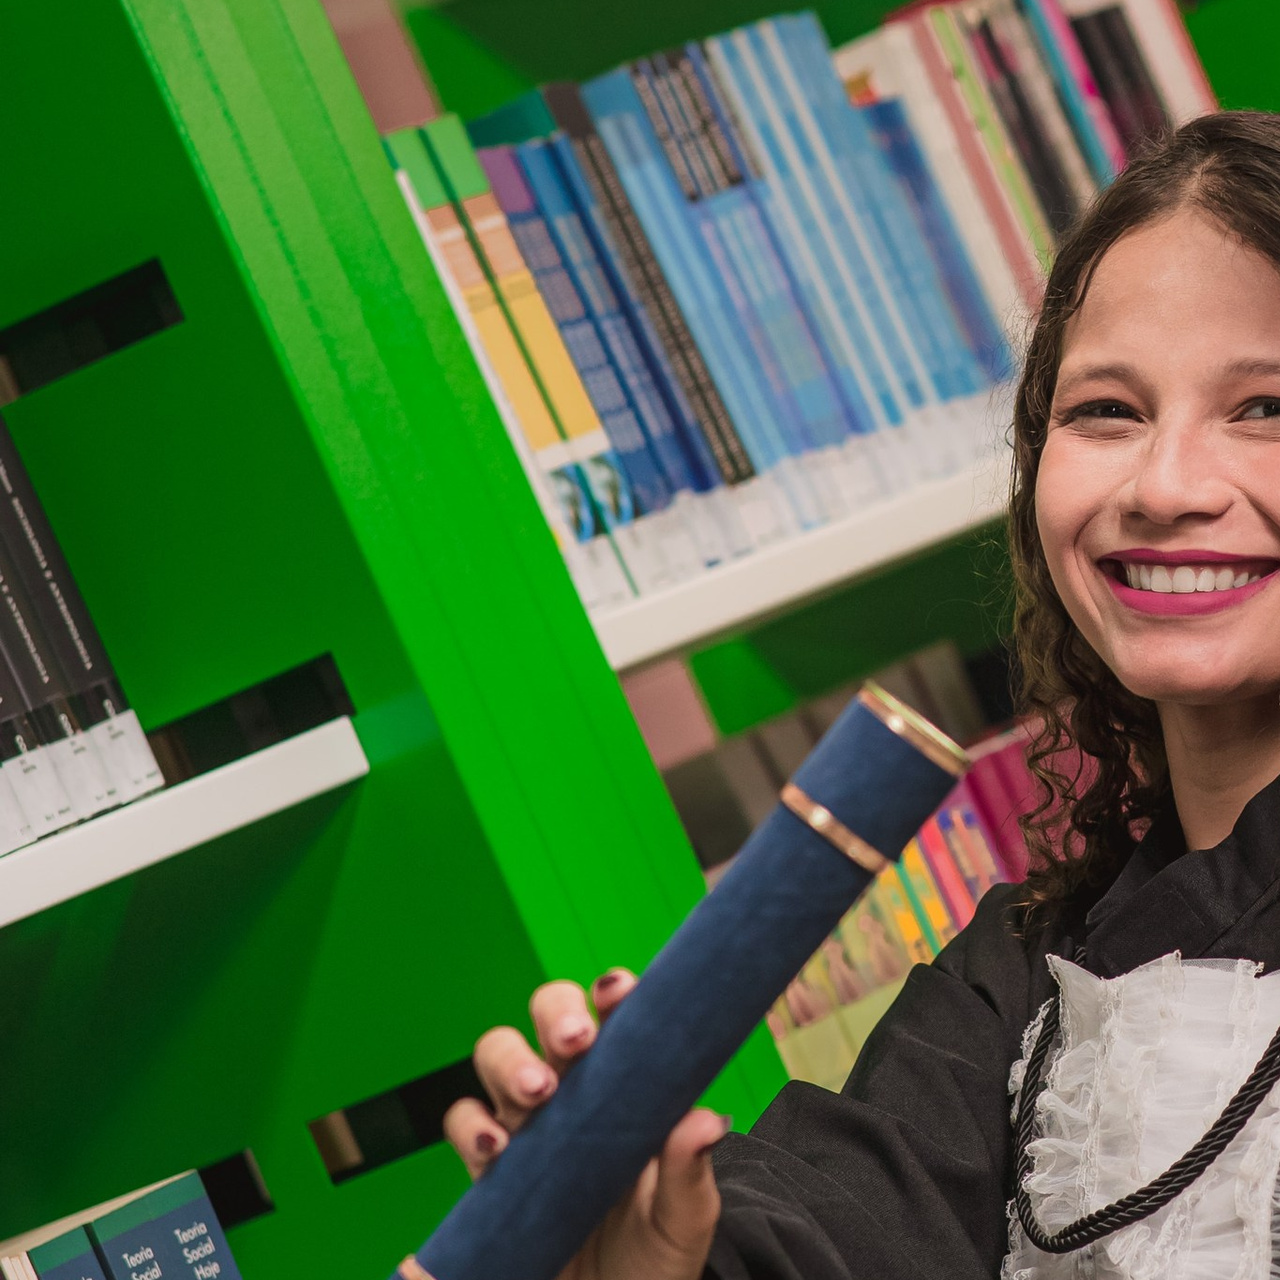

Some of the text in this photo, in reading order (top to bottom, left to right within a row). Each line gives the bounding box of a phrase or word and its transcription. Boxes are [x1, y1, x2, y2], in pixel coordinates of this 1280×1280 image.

[174, 1221, 208, 1244] Teoria
[122, 1246, 154, 1269] Teoria
[183, 1236, 216, 1264] Social
[194, 1261, 221, 1280] Hoje
